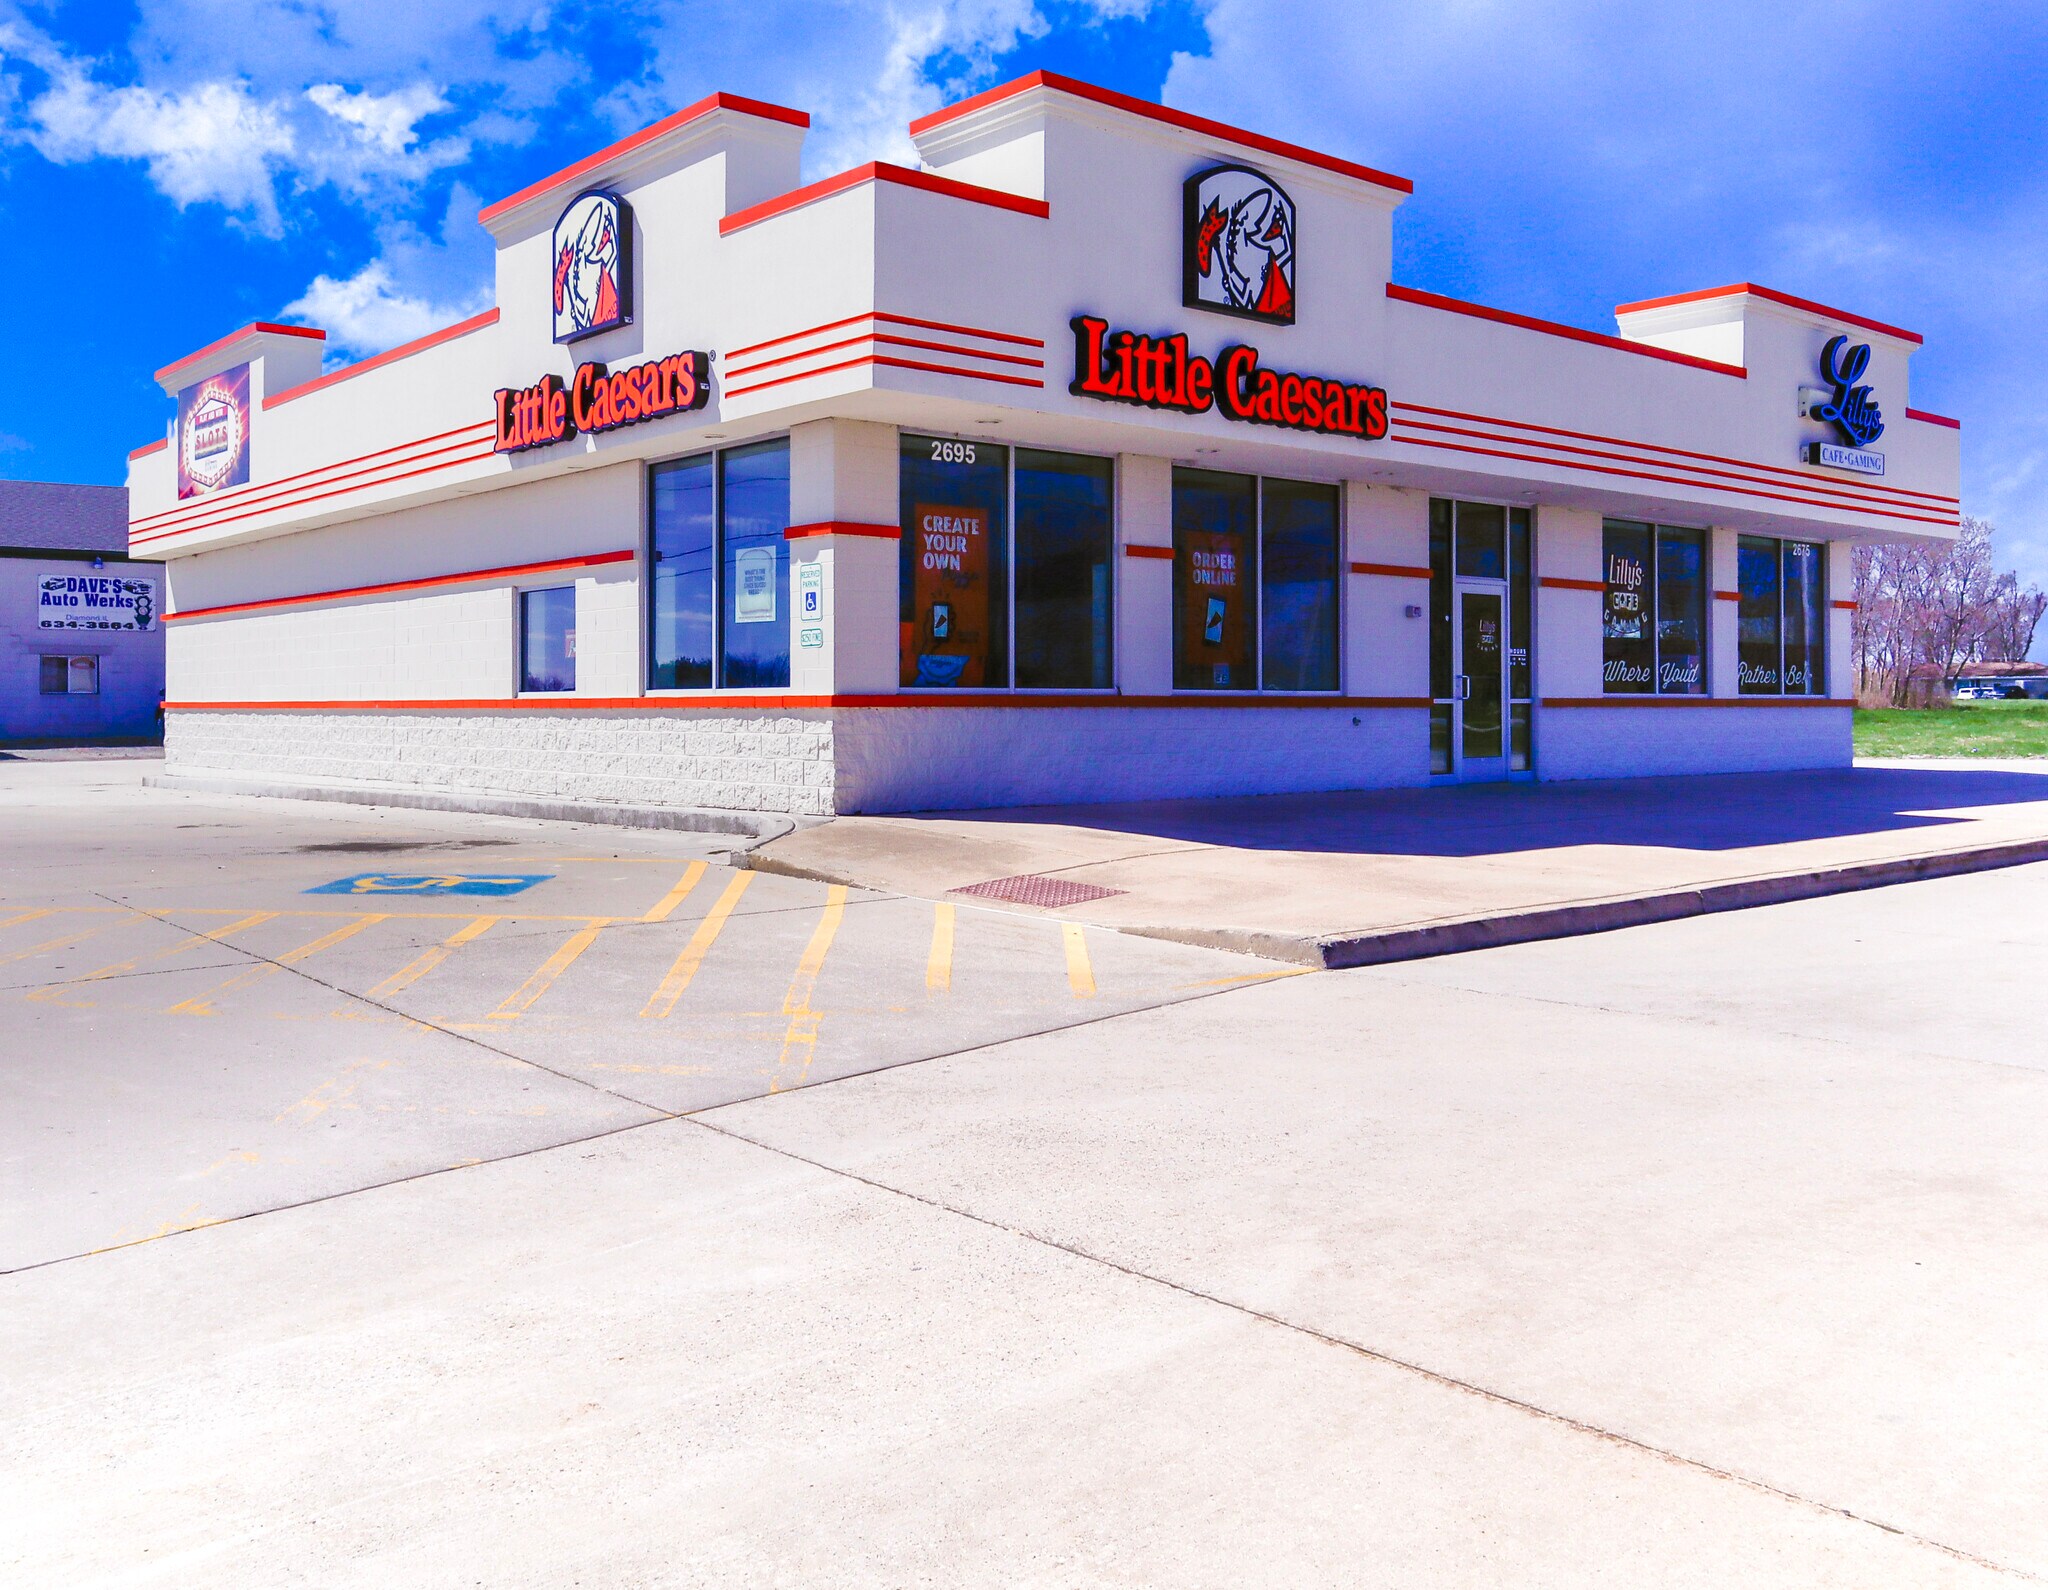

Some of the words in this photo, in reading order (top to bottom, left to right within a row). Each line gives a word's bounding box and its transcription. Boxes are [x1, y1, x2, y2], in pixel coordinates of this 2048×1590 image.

[1072, 316, 1213, 413] Little
[1219, 344, 1388, 439] Caesars
[494, 374, 571, 454] Little
[573, 350, 702, 434] Caesars
[196, 425, 227, 449] SLOTS
[931, 441, 976, 464] 2695
[923, 515, 979, 535] CREATE
[923, 534, 967, 553] YOUR
[923, 553, 960, 571] OWN
[1193, 551, 1236, 569] ORDER
[1193, 569, 1236, 586] ONLINE
[1608, 554, 1643, 590] Lilly's
[67, 577, 124, 593] DAVE'S
[40, 592, 79, 606] Auto
[84, 593, 134, 608] Werks
[1603, 660, 1650, 682] Where
[1737, 661, 1777, 686] Rather
